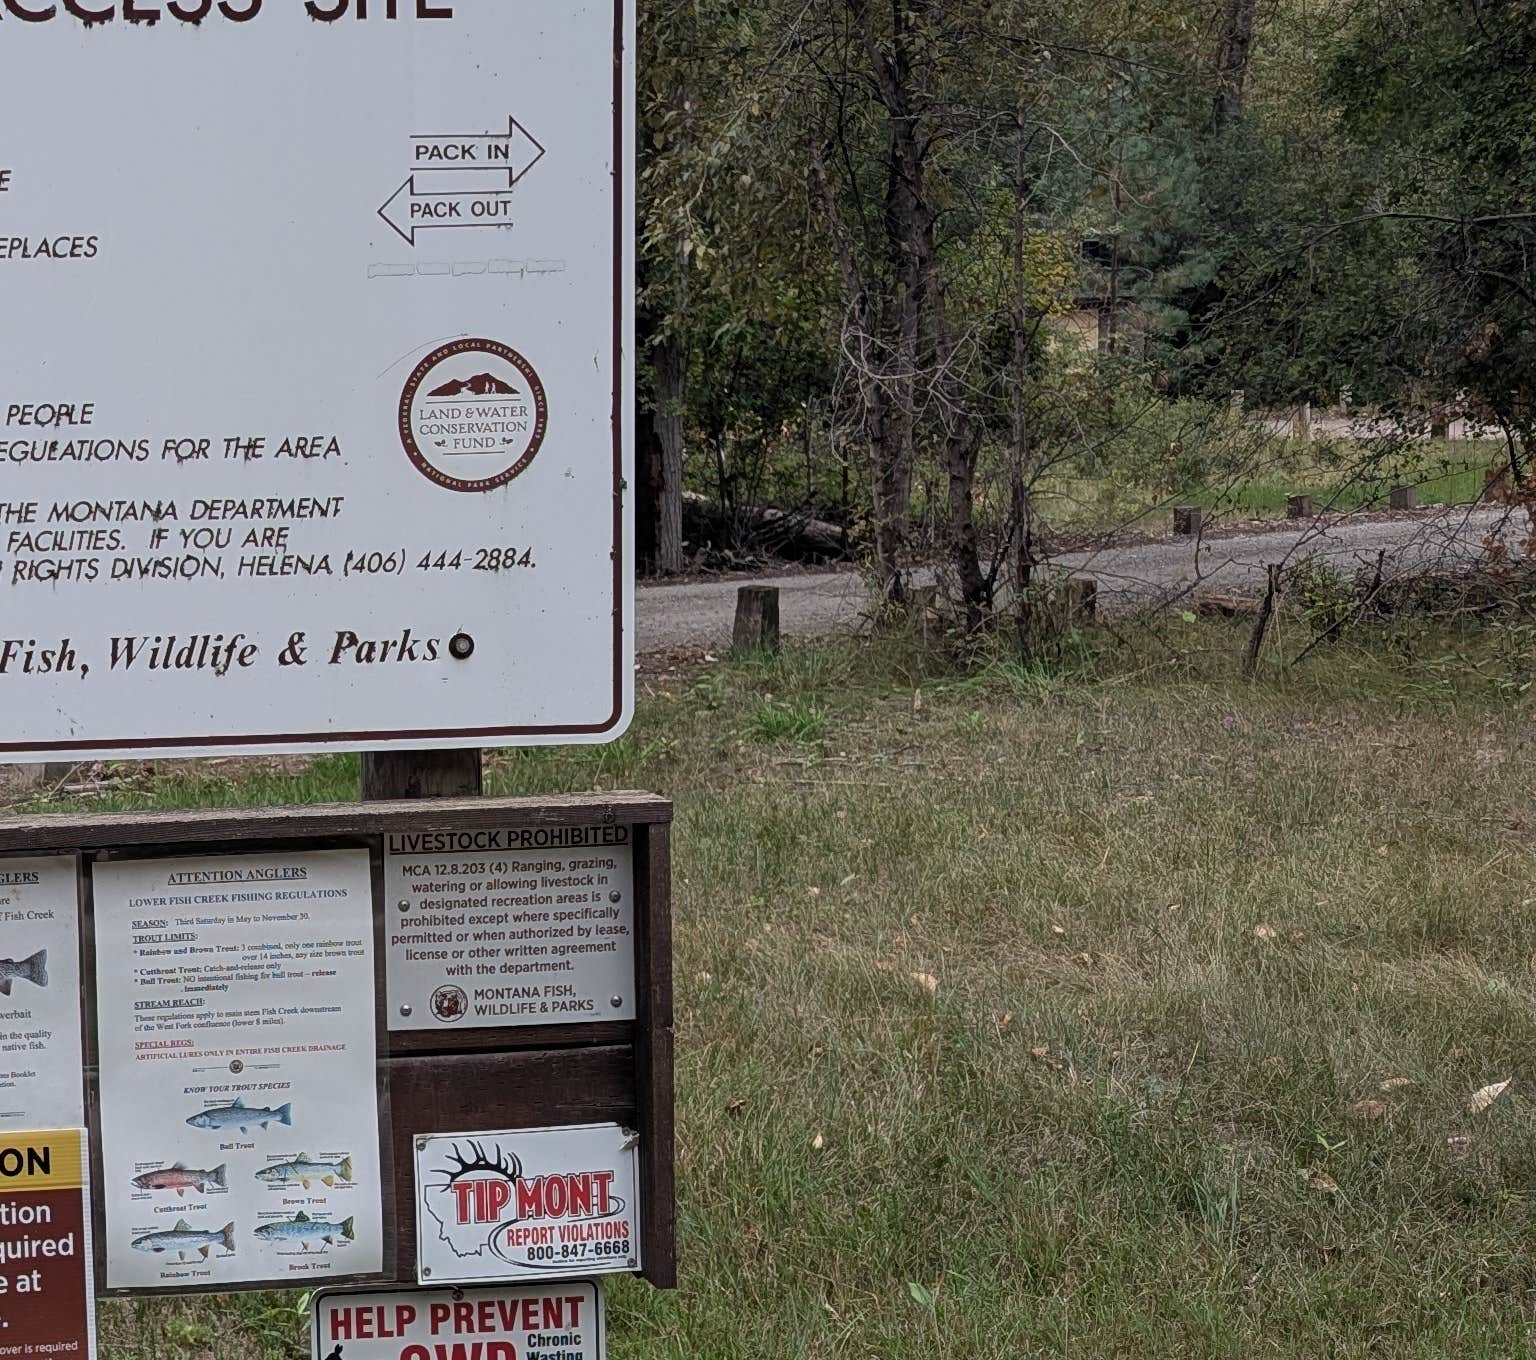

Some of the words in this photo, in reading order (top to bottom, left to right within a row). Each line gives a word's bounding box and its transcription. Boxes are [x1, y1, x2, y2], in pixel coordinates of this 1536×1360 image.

[415, 144, 479, 161] PACK
[488, 144, 509, 161] IN
[410, 201, 462, 219] PACK
[470, 200, 512, 218] OUT
[6, 404, 94, 428] PEOPLE
[418, 407, 465, 423] LAND
[464, 406, 475, 422] &
[474, 405, 530, 421] WATER
[419, 420, 528, 436] CONSERVATION
[452, 435, 497, 451] FUND
[111, 634, 257, 677] Wildlife
[278, 632, 307, 665] &
[328, 629, 440, 664] Parks
[389, 831, 501, 852] LIVESTOCK
[507, 825, 628, 847] PROHIBITED
[167, 869, 244, 885] ATTENTION
[246, 866, 308, 882] ANGLERS
[402, 864, 432, 877] MCA
[434, 862, 486, 876] 12.8.203
[489, 861, 508, 875] (4)
[511, 859, 566, 874] Ranging,
[568, 856, 619, 873] grazing,
[411, 880, 466, 894] watering
[469, 881, 483, 892] or
[485, 877, 538, 891] allowing
[540, 873, 594, 888] livestock
[597, 872, 609, 886] in
[129, 897, 167, 908] LOWER
[169, 896, 192, 906] FISH
[193, 894, 229, 904] CREEK
[231, 892, 273, 903] FISHING
[275, 888, 348, 901] REGULATIONS
[474, 986, 541, 1001] MONTANA
[543, 984, 577, 998] FISH,
[474, 1002, 537, 1016] WILDLIFE
[539, 1001, 549, 1014] &
[551, 999, 594, 1013] PARKS
[451, 1179, 511, 1224] TIP
[516, 1171, 613, 1220] MONT
[507, 1227, 554, 1246] REPORT
[559, 1221, 629, 1241] VIOLATIONS
[527, 1240, 630, 1260] 800-847-6668
[16, 1270, 41, 1292] at
[330, 1305, 416, 1340] HELP
[430, 1296, 584, 1334] PREVENT
[526, 1331, 582, 1349] Chronic
